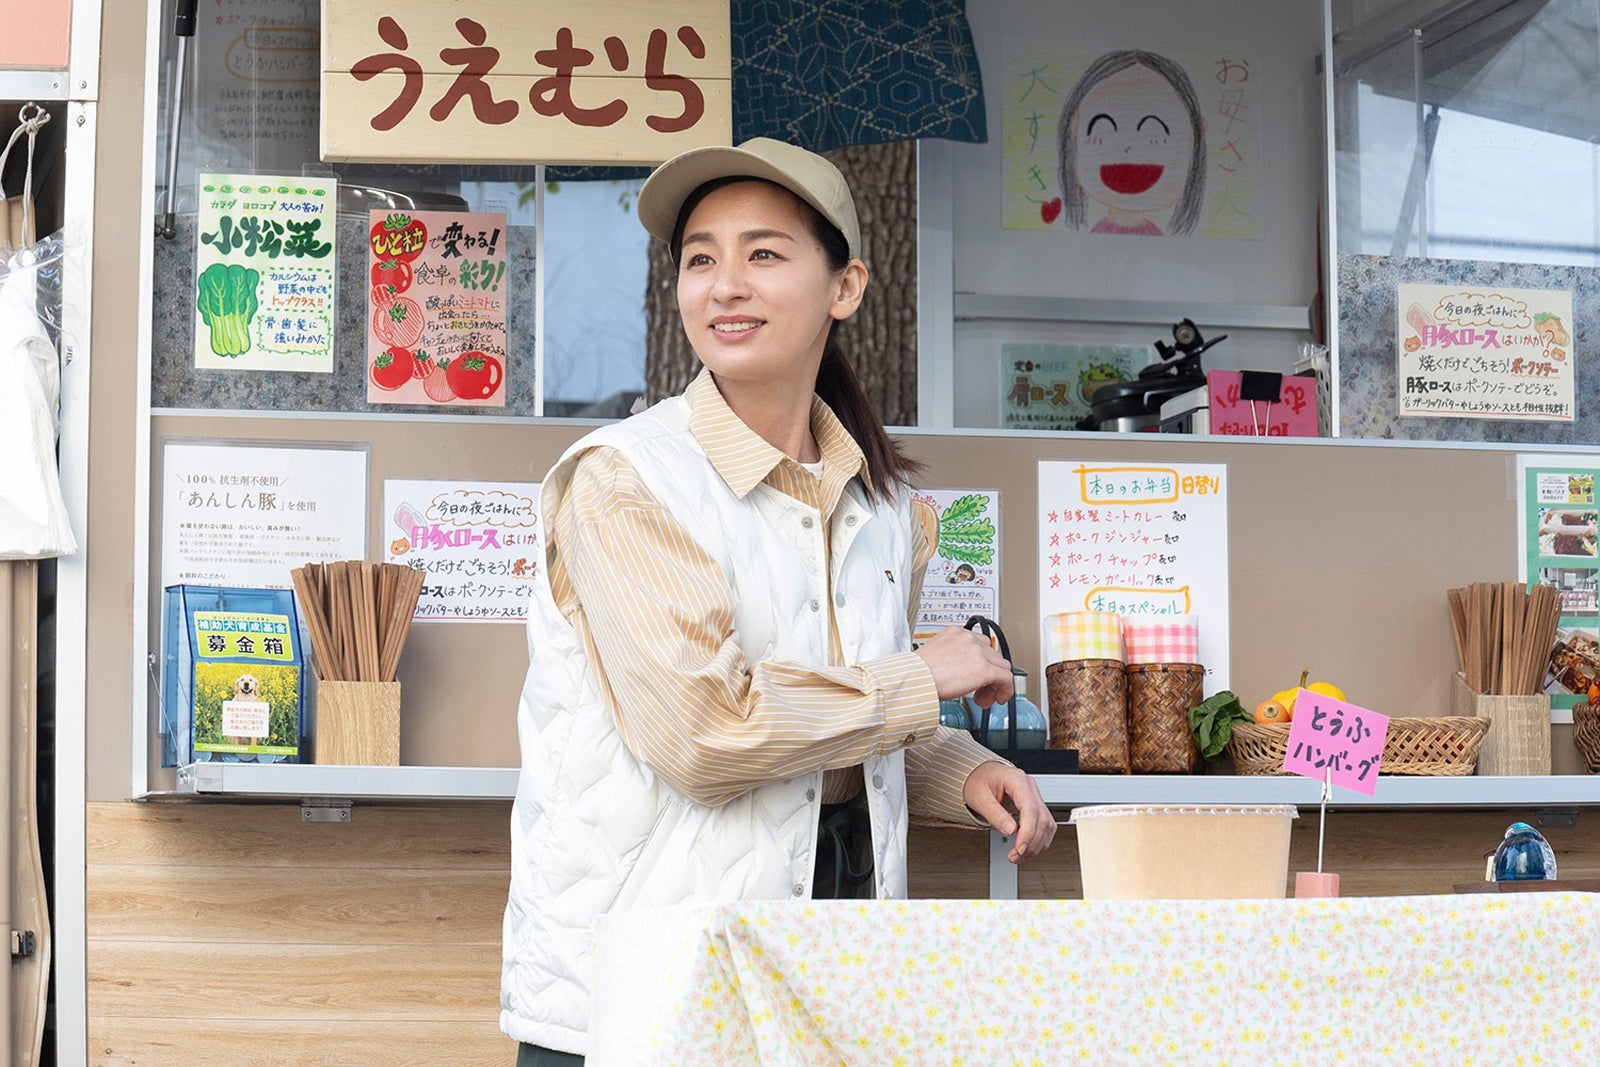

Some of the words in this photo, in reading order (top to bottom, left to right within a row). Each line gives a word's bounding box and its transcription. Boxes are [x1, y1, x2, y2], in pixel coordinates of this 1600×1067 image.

[349, 16, 705, 133] うえむら
[1019, 64, 1059, 204] 大すき
[201, 215, 332, 259] 小松菜
[269, 272, 317, 282] カルシウムは
[278, 284, 328, 296] 野菜の中でも
[1444, 302, 1518, 318] 今日の夜ごはんに
[274, 333, 325, 344] 強いみかた
[1089, 475, 1171, 495] 本日のお弁当
[1182, 476, 1220, 495] 日替り
[179, 490, 317, 512] 「あんしん豚」を使用
[437, 500, 522, 516] 今日の夜ごはんに
[1092, 594, 1184, 615] 本日のスペシャル
[207, 634, 284, 655] 募金箱
[1311, 706, 1371, 743] とうふ
[1293, 742, 1380, 781] ハンバーグ
